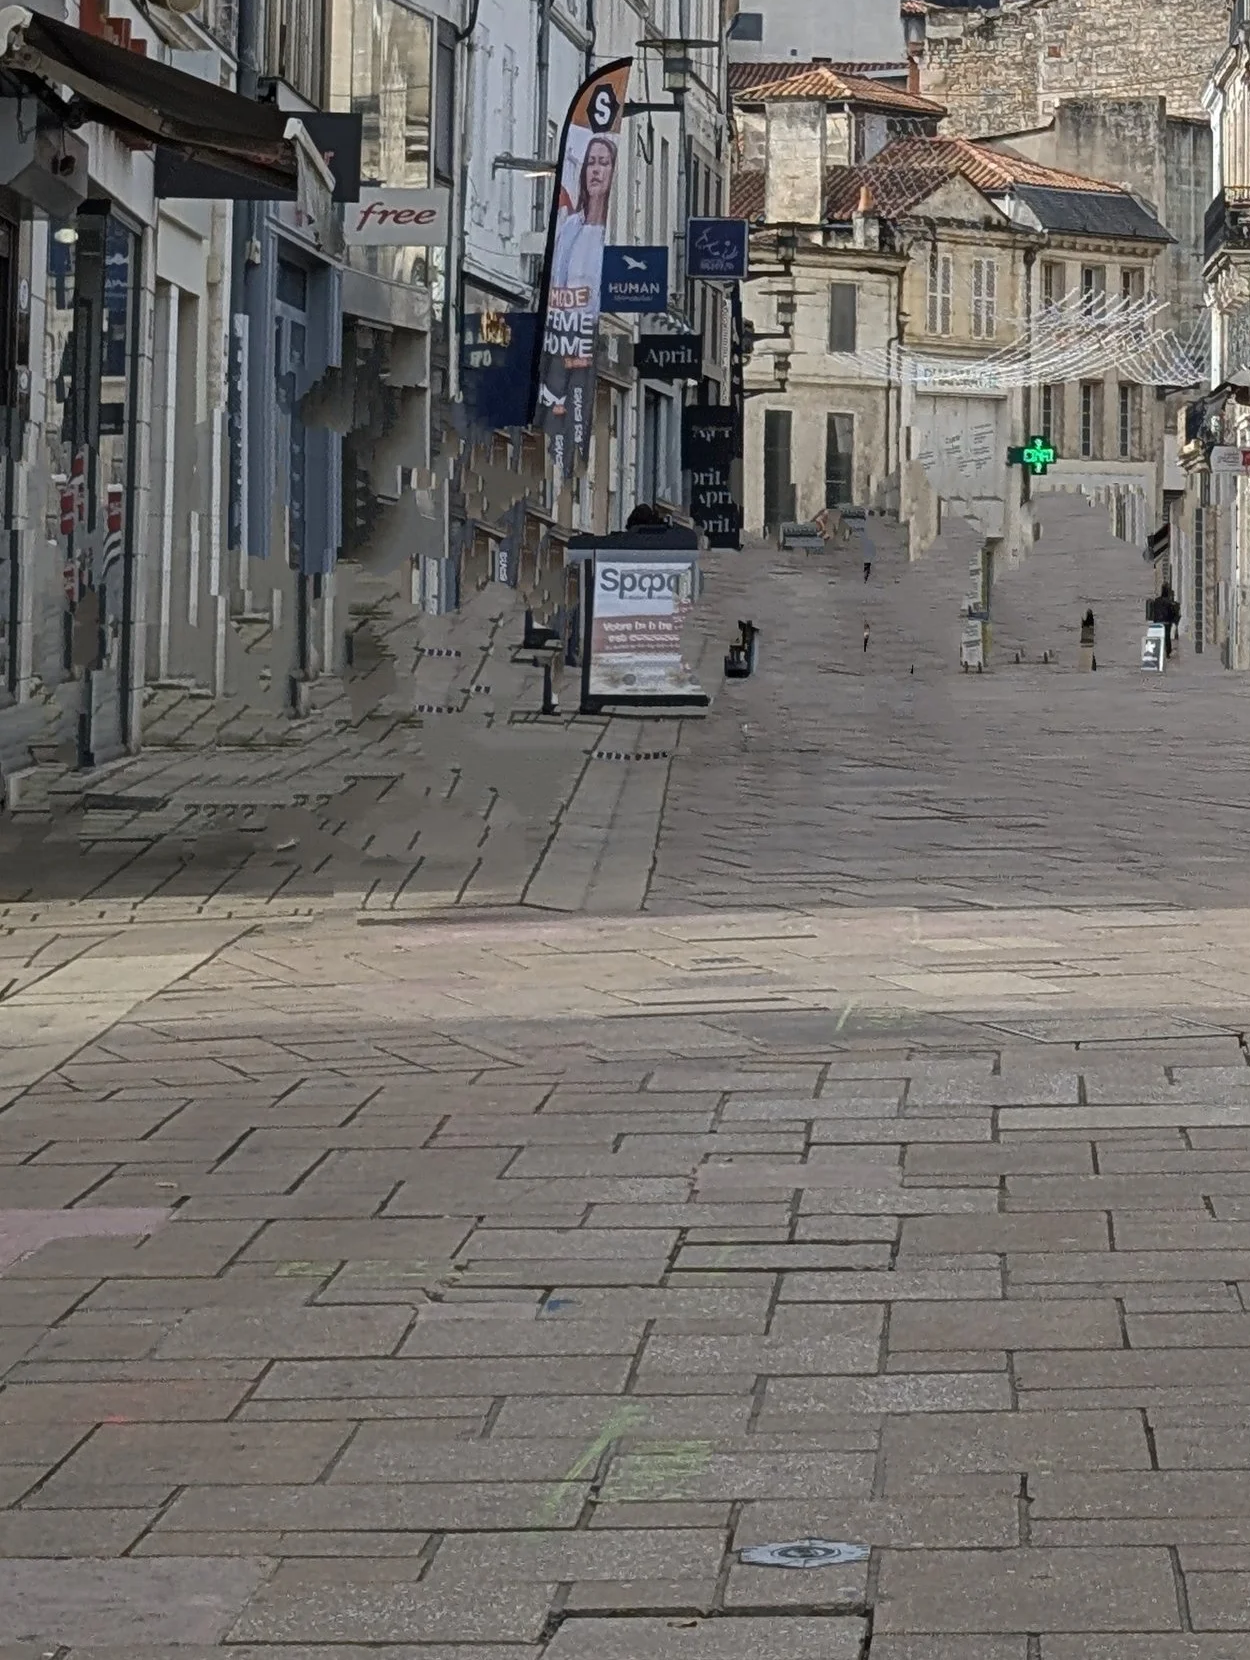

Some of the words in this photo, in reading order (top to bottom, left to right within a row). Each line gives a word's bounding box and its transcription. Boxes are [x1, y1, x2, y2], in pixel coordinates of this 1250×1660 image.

[594, 91, 611, 126] S
[356, 201, 438, 232] free
[608, 283, 660, 295] HUMAN
[643, 345, 698, 368] April.
